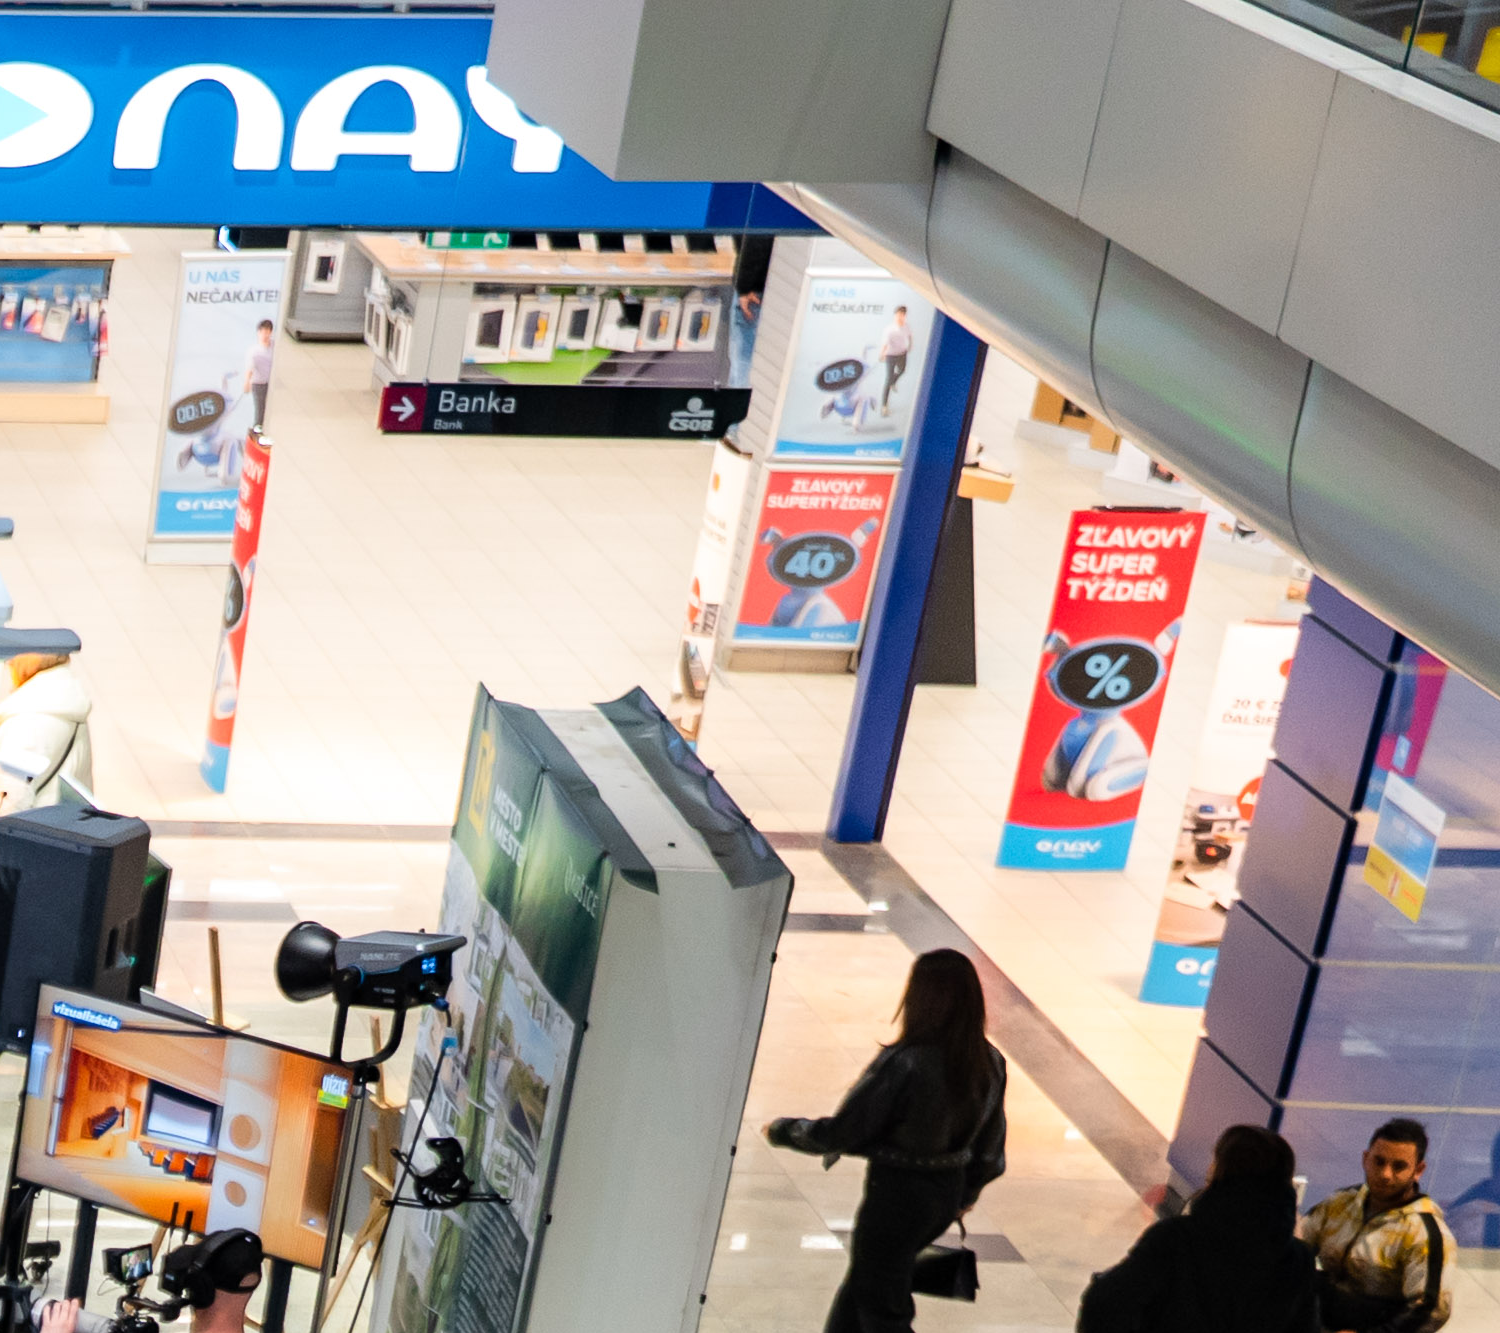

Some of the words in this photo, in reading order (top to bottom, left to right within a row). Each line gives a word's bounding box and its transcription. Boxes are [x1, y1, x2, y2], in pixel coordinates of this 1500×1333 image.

[188, 271, 201, 284] U
[206, 267, 241, 284] NÁS
[185, 287, 280, 305] NEČAKÁTE!
[437, 389, 516, 415] Banka
[433, 419, 463, 431] Bank
[668, 416, 714, 432] ČSOB
[791, 477, 867, 494] ZĽAVOVÝ
[1075, 521, 1196, 549] ZĽAVOVÝ
[1070, 553, 1158, 575] SUPER
[1066, 576, 1169, 602] TÝŽDEŇ
